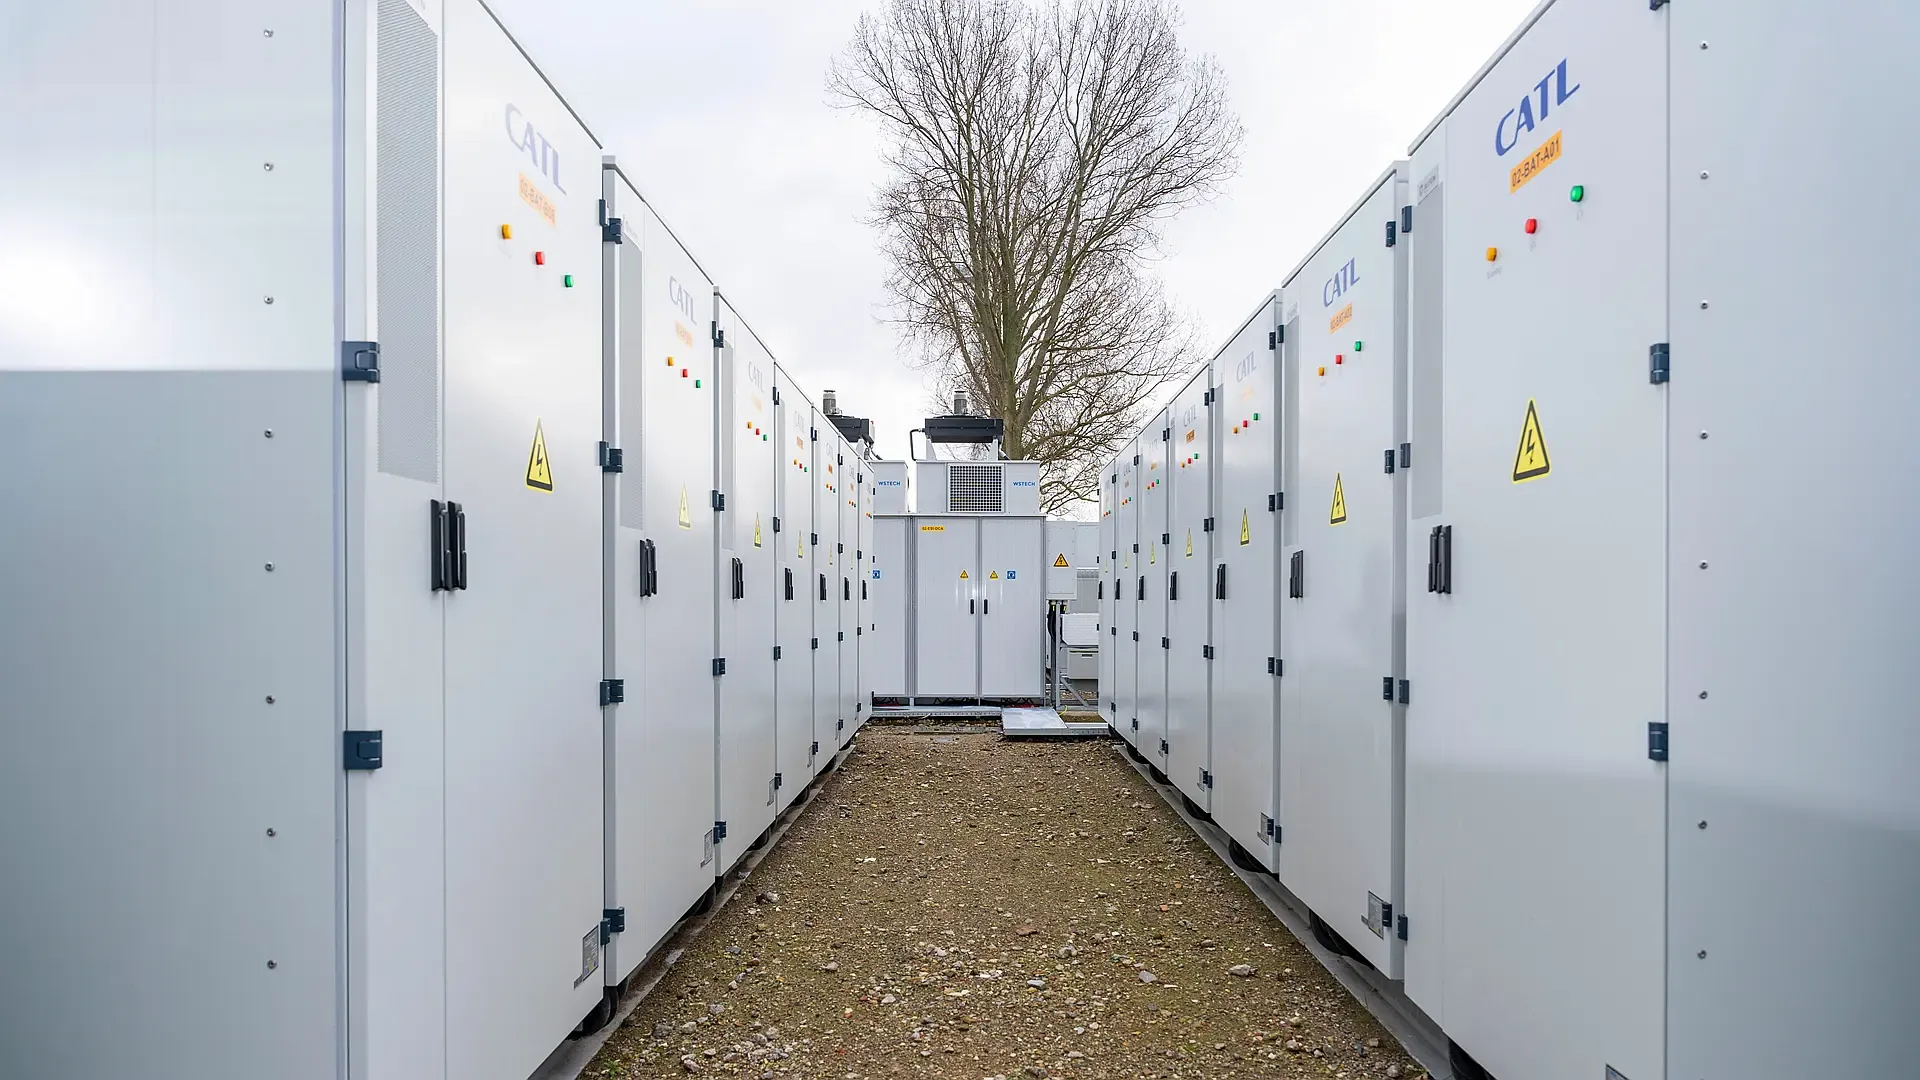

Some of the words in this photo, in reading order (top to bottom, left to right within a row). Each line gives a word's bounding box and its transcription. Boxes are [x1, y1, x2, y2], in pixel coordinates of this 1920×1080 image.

[1495, 57, 1580, 157] CATL
[505, 102, 567, 195] CATL
[1511, 137, 1561, 187] 02-BAT-A01
[669, 276, 698, 326] CATL
[1324, 257, 1361, 308] CATL
[748, 361, 765, 393] CATL
[1236, 350, 1257, 383] CATL
